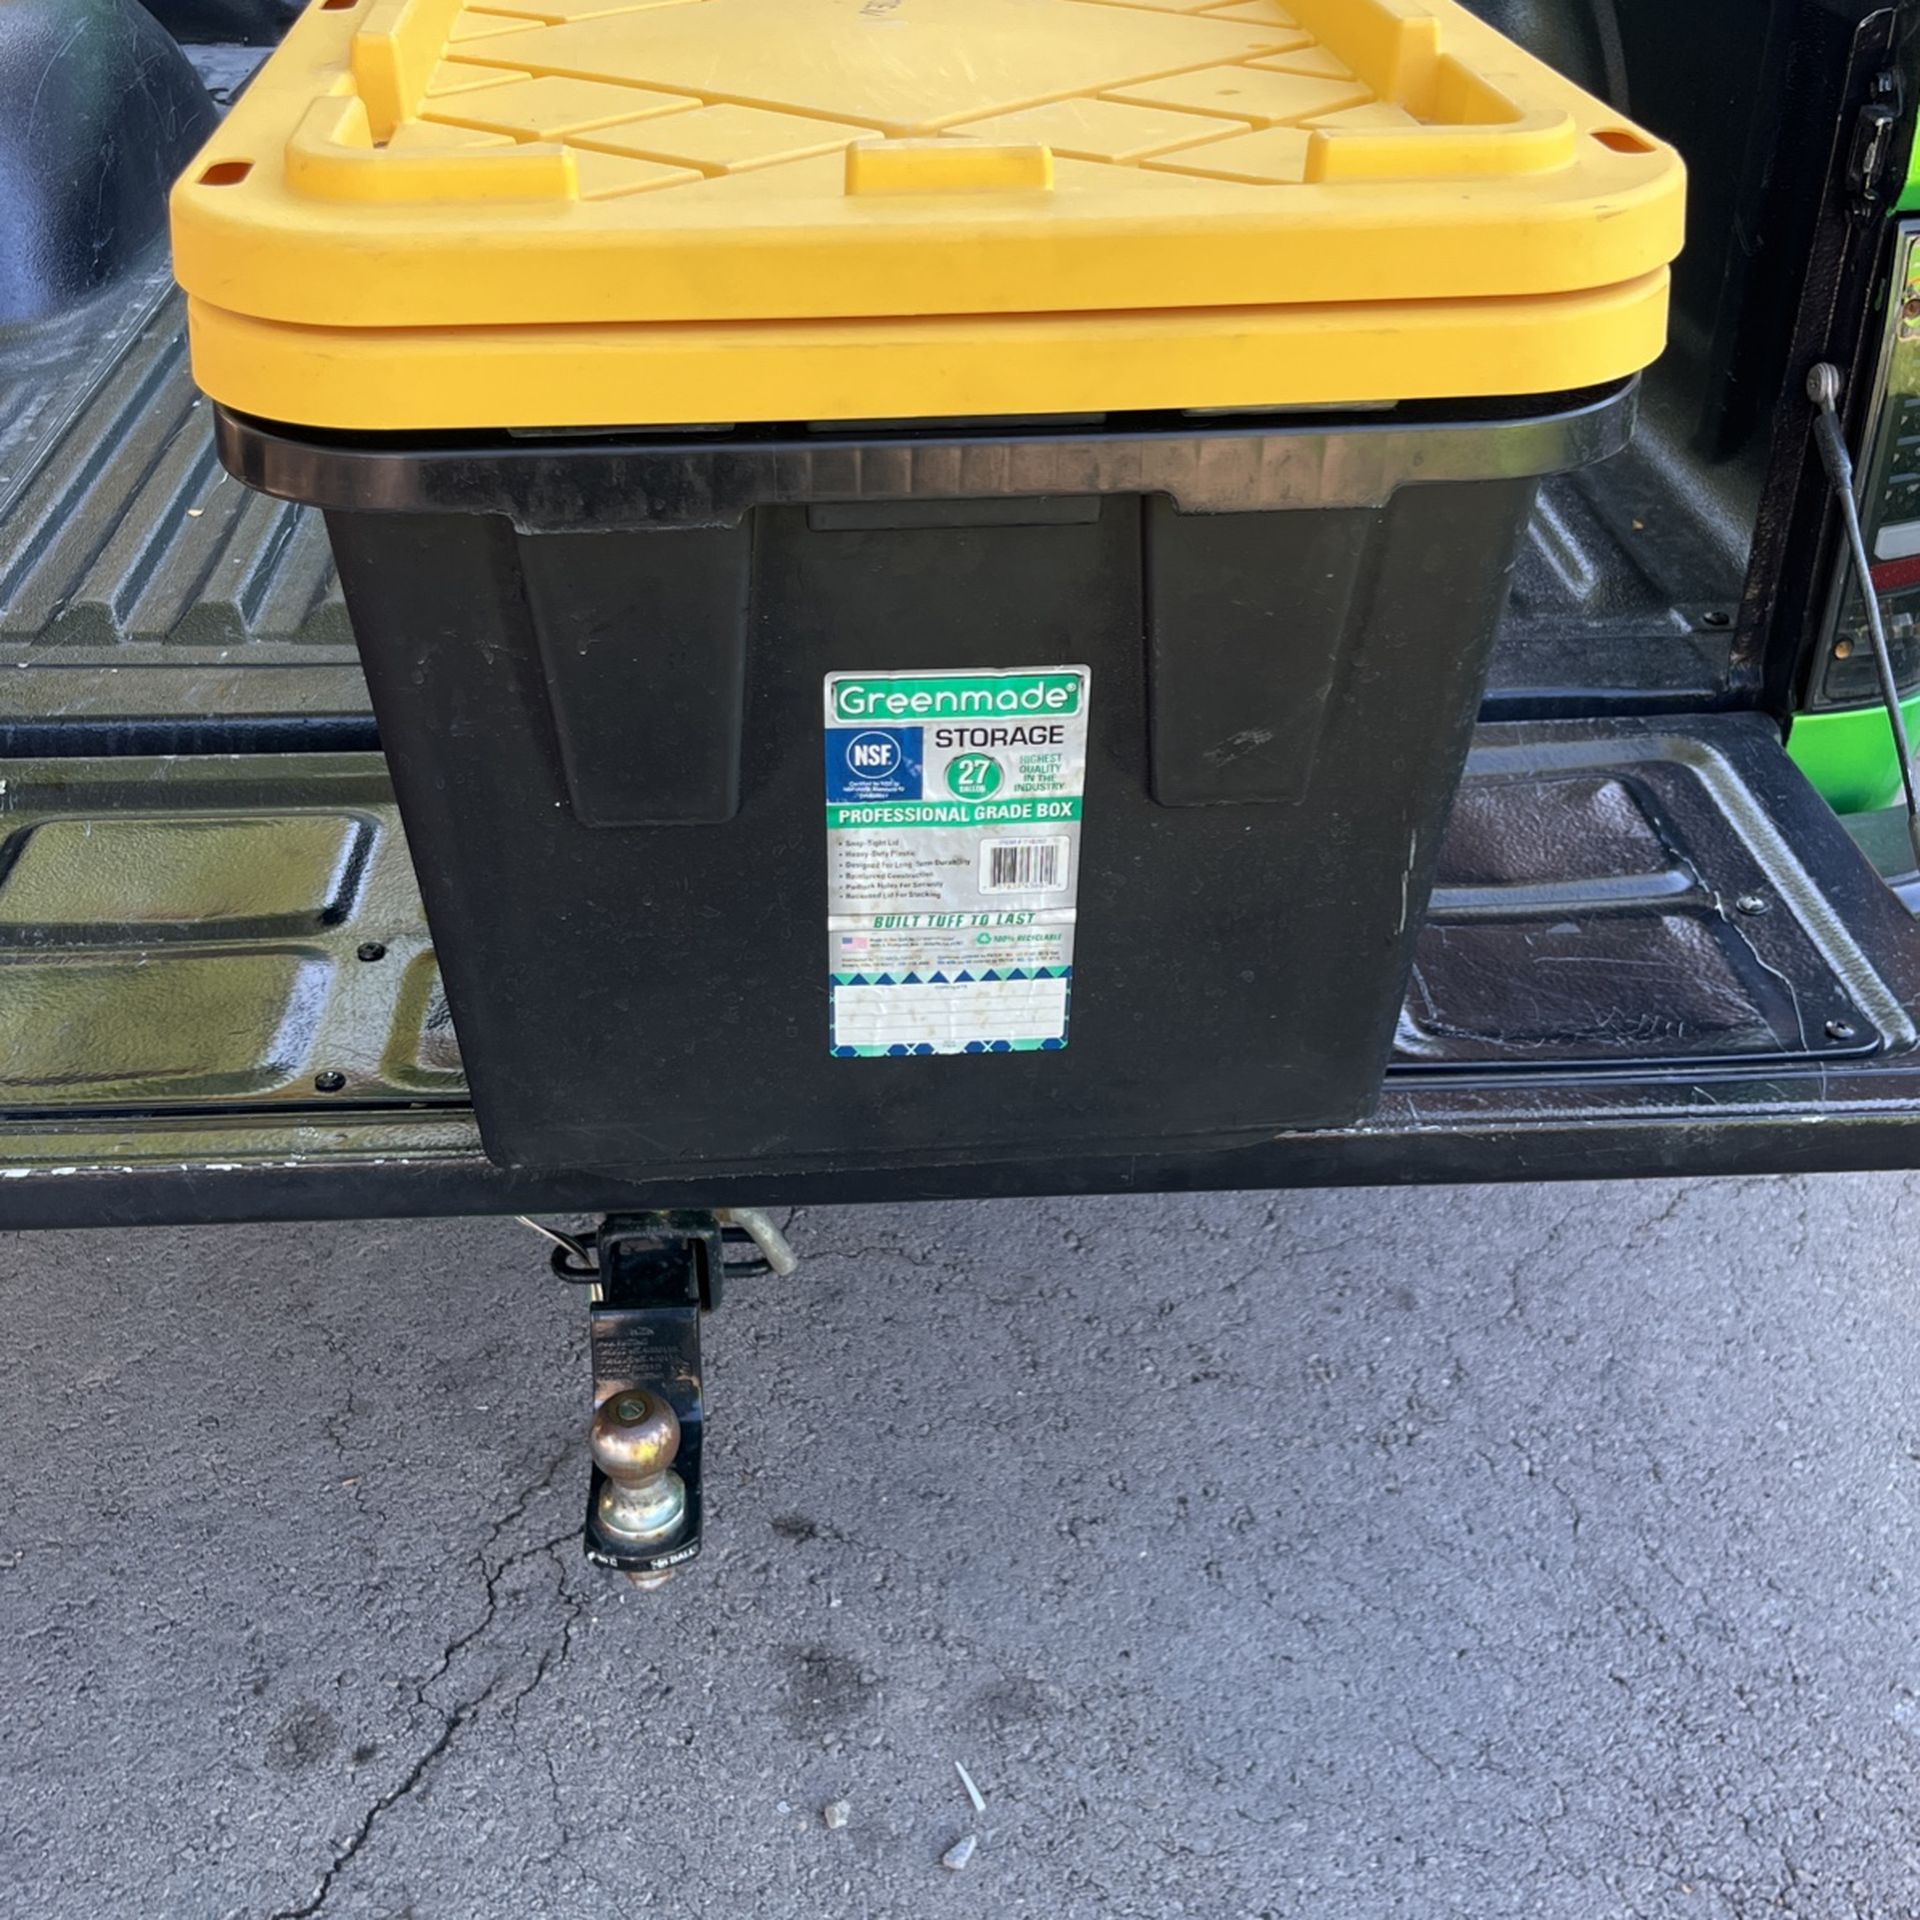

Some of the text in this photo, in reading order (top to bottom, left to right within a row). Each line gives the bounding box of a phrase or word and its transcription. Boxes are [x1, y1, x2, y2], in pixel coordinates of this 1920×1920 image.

[935, 725, 1065, 748] STORAGE
[1019, 753, 1063, 764] HIGHEST
[958, 759, 991, 785] 27
[1019, 763, 1061, 774] QUALITY
[1023, 773, 1055, 782] IN THE
[1013, 782, 1065, 792] INDUSTRY
[838, 801, 1073, 824] PROFESSIONAL GRADE BOX
[873, 912, 1037, 929] BUILT TUFF TO LAST
[1016, 933, 1062, 942] RECYCLABLE
